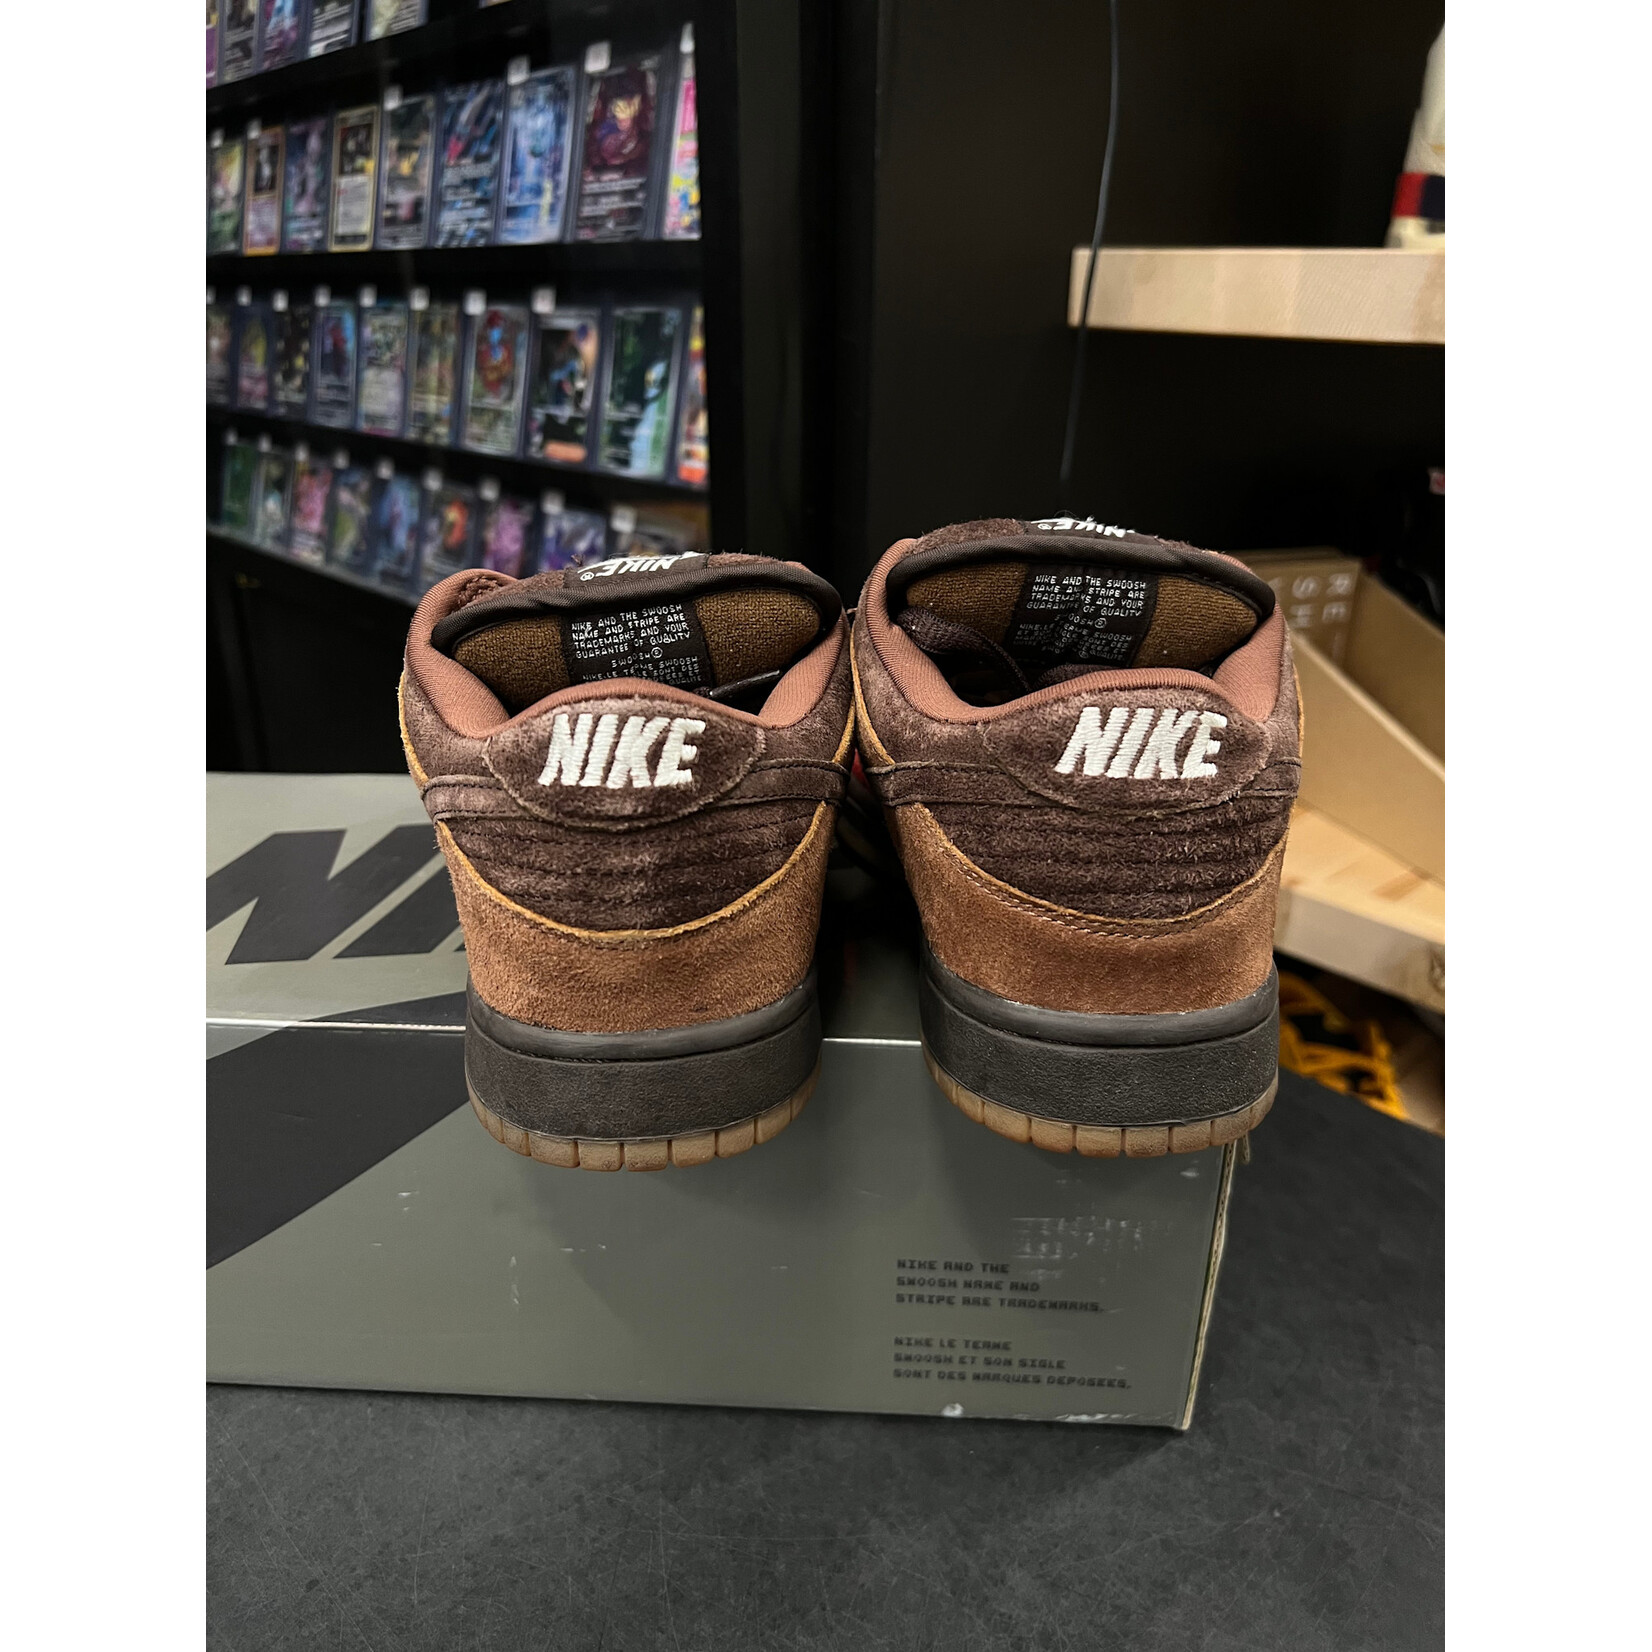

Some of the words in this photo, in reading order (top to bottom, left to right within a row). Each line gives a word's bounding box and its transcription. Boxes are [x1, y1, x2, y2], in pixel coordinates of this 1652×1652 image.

[1034, 575, 1057, 584] NIKE
[1062, 576, 1082, 586] AND
[1086, 576, 1102, 587] THE
[1106, 579, 1146, 590] SWOOSH
[1032, 585, 1060, 593] NAME
[1088, 587, 1120, 598] STRIPE
[1128, 590, 1145, 600] ARE
[1096, 596, 1115, 607] AND
[1121, 599, 1144, 610] YOUR
[571, 622, 592, 632] NIKE
[598, 616, 616, 628] AND
[620, 611, 638, 622] THE
[642, 604, 682, 618] SWOOSH
[1083, 605, 1096, 614] OF
[1100, 608, 1142, 617] QUALITY
[572, 628, 598, 641] NAME
[605, 624, 624, 636] AND
[628, 616, 660, 630] STRIPE
[666, 613, 686, 622] ARE
[574, 630, 635, 650] TRADEMARKS
[640, 627, 660, 638] AND
[664, 622, 689, 633] YOUR
[1093, 631, 1132, 642] SWOOSH
[576, 643, 629, 659] GUARANTEE
[634, 639, 644, 647] OF
[650, 632, 690, 646] QUALITY
[659, 656, 698, 669] SWOOSH
[1054, 706, 1228, 779] NIKE
[537, 713, 706, 789] NIKE
[897, 1259, 938, 1270] NIKE
[943, 1261, 974, 1272] AND
[981, 1263, 1010, 1274] THE
[896, 1276, 957, 1288] SWOOSH
[963, 1280, 1004, 1290] NAME
[1009, 1281, 1040, 1292] AND
[896, 1294, 956, 1306] STRIPE
[962, 1296, 991, 1307] ARE
[894, 1336, 934, 1348] NIKE
[940, 1338, 956, 1349] LE
[964, 1339, 1012, 1351] TERME
[894, 1353, 953, 1364] SWOOSH
[959, 1355, 977, 1365] ET
[984, 1356, 1013, 1367] SON
[1019, 1358, 1066, 1370] SIGLE
[894, 1368, 932, 1379] SONT
[938, 1370, 966, 1381] DES
[972, 1372, 1041, 1384] MARQUES
